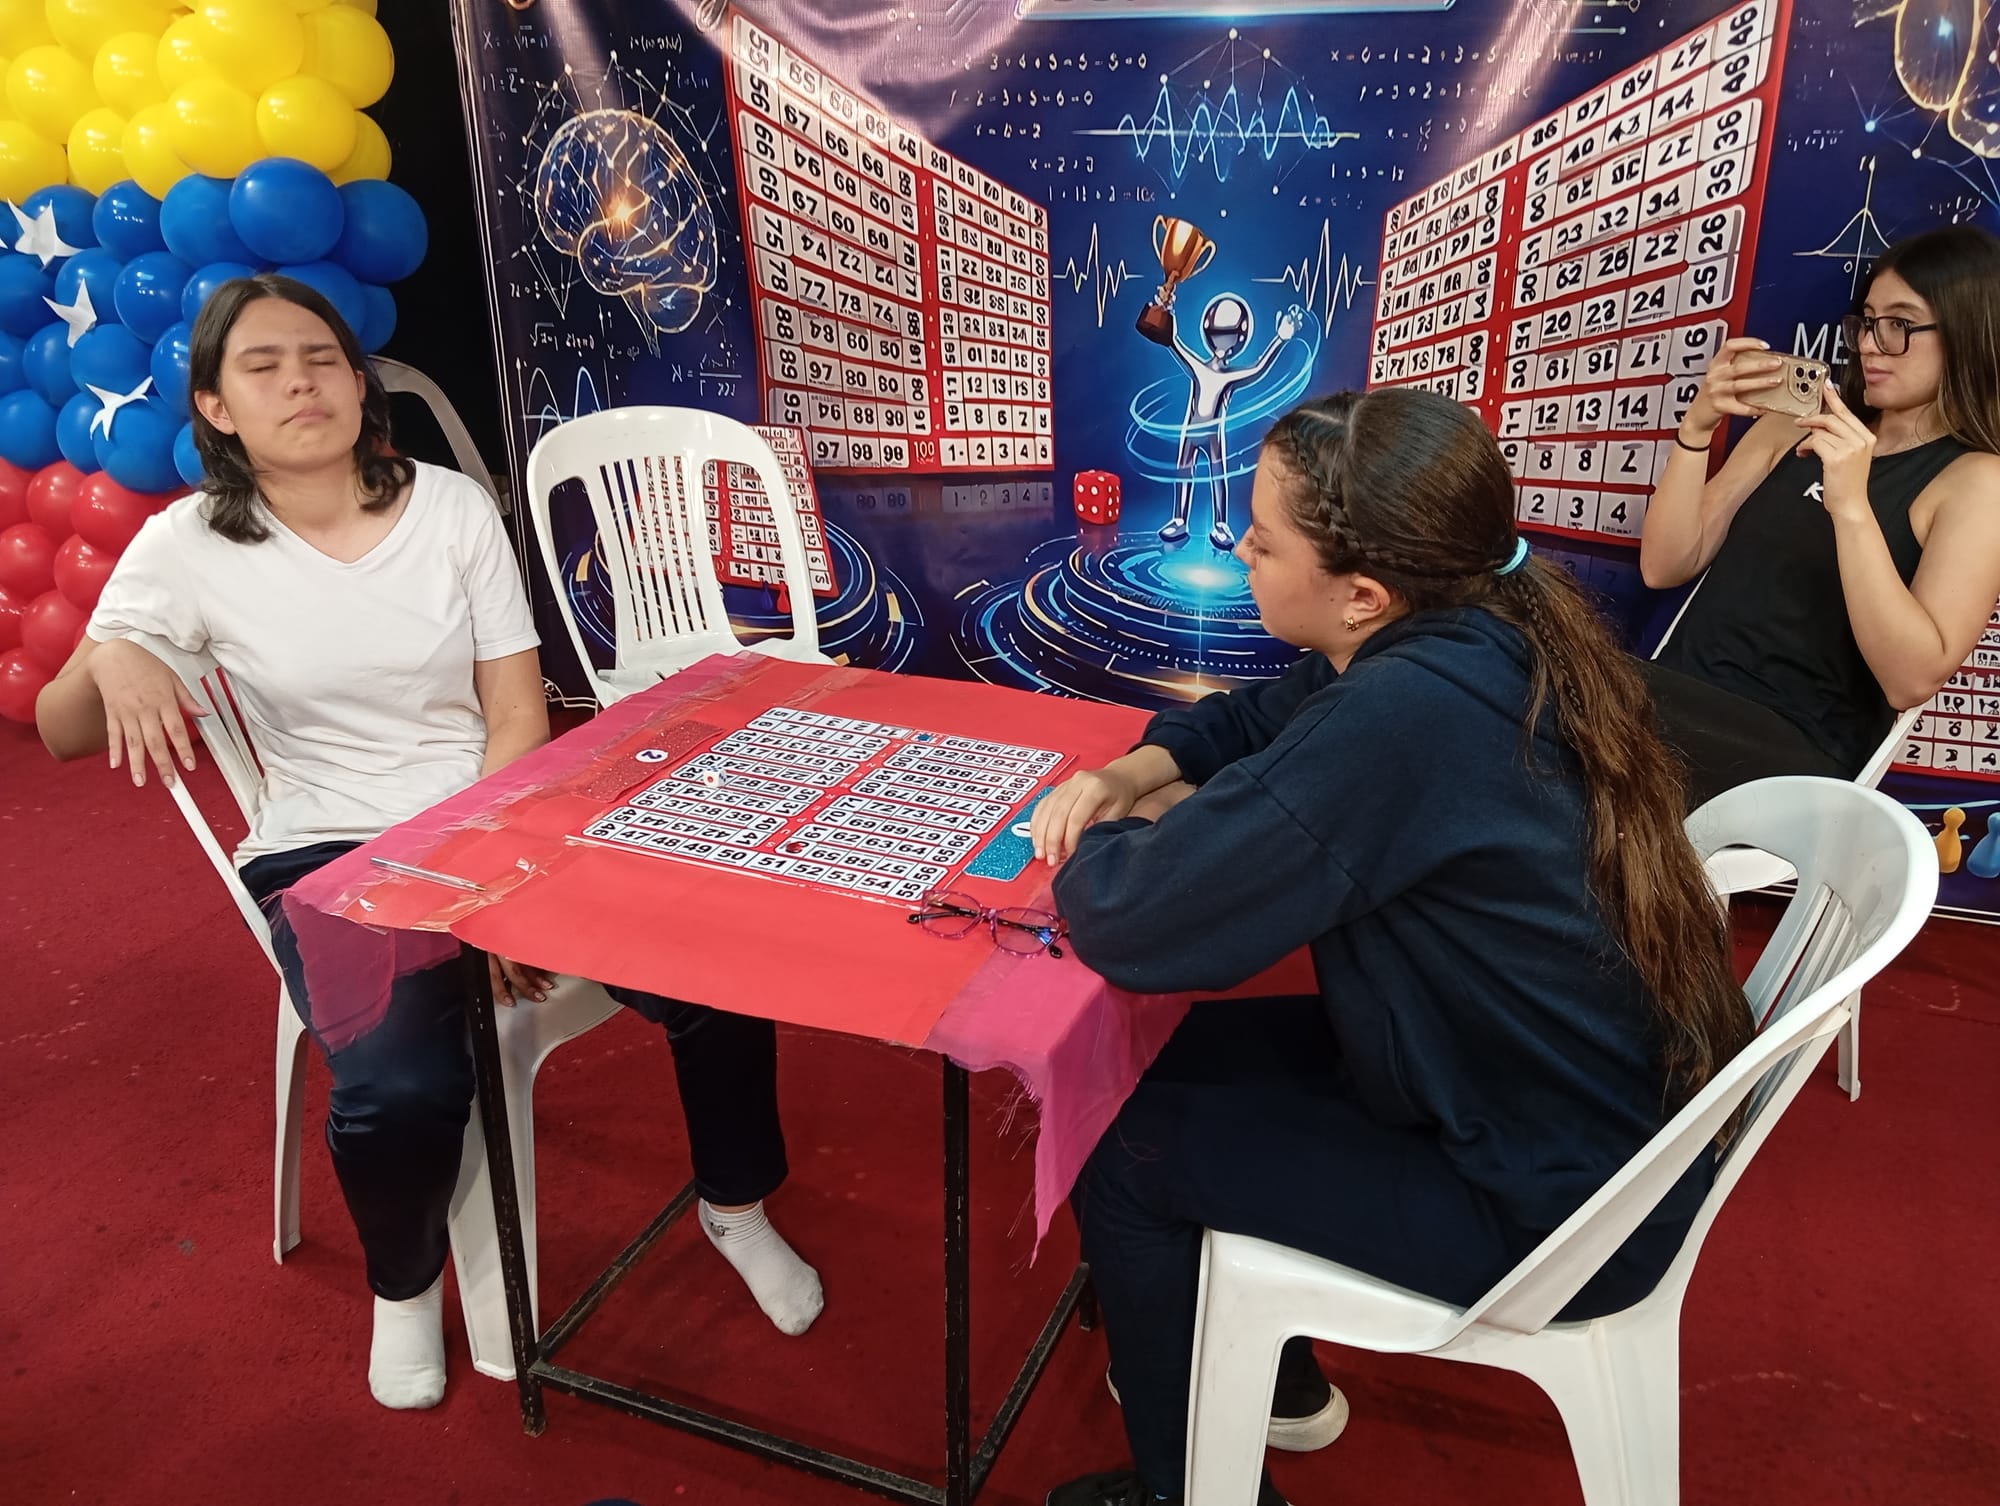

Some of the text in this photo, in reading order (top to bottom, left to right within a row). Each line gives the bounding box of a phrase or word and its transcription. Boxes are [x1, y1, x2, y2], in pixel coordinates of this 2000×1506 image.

[1728, 6, 1758, 46] 46
[749, 29, 770, 73] 55
[750, 74, 810, 133] 56 67
[1713, 110, 1742, 151] 36
[1706, 159, 1735, 199] 35
[792, 190, 818, 216] 67
[764, 215, 785, 251] 75
[1698, 213, 1727, 254] 26
[769, 259, 789, 292] 78
[800, 277, 826, 301] 77
[839, 292, 862, 312] 78
[1544, 266, 1718, 336] 20 24 25
[775, 305, 794, 340] 88
[780, 349, 798, 380] 89
[809, 361, 832, 381] 97
[1682, 327, 1708, 368] 16
[784, 393, 801, 424] 95
[1534, 403, 1560, 424] 12
[1576, 398, 1602, 422] 13
[1617, 394, 1648, 418] 14
[817, 441, 840, 458] 97
[914, 441, 935, 458] 100
[976, 443, 985, 460] 2
[999, 443, 1009, 458] 3
[1020, 444, 1028, 458] 4
[1531, 493, 1627, 524] 2 3 4
[734, 732, 757, 741] 15
[890, 757, 913, 767] 90
[935, 750, 958, 758] 92
[1023, 764, 1043, 774] 95
[1906, 744, 1921, 759] 2
[699, 755, 722, 769] 25
[812, 774, 834, 786] 21
[859, 782, 881, 794] 80
[978, 805, 1002, 817] 76
[774, 752, 798, 760] 18
[828, 762, 850, 772] 20
[902, 775, 928, 784] 82
[933, 780, 959, 789] 83
[963, 786, 990, 794] 84
[995, 790, 1016, 801] 85
[658, 782, 681, 793] 35
[776, 802, 798, 814] 31
[822, 810, 846, 822] 70
[678, 767, 700, 779] 26
[734, 778, 761, 787] 28
[764, 783, 791, 792] 29
[794, 788, 816, 800] 30
[840, 798, 864, 808] 71
[870, 802, 896, 812] 72
[902, 808, 927, 818] 73
[933, 813, 959, 824] 74
[964, 818, 988, 831] 75
[614, 809, 636, 822] 45
[736, 832, 758, 845] 41
[913, 867, 938, 880] 56
[638, 794, 662, 806] 36
[665, 800, 693, 809] 37
[694, 806, 722, 815] 38
[726, 812, 753, 821] 39
[755, 818, 777, 830] 40
[833, 832, 861, 842] 62
[866, 838, 893, 848] 63
[898, 841, 926, 854] 64
[932, 849, 955, 862] 65
[592, 823, 921, 898] 46 47 48 49 50 51 52 53 54 55
